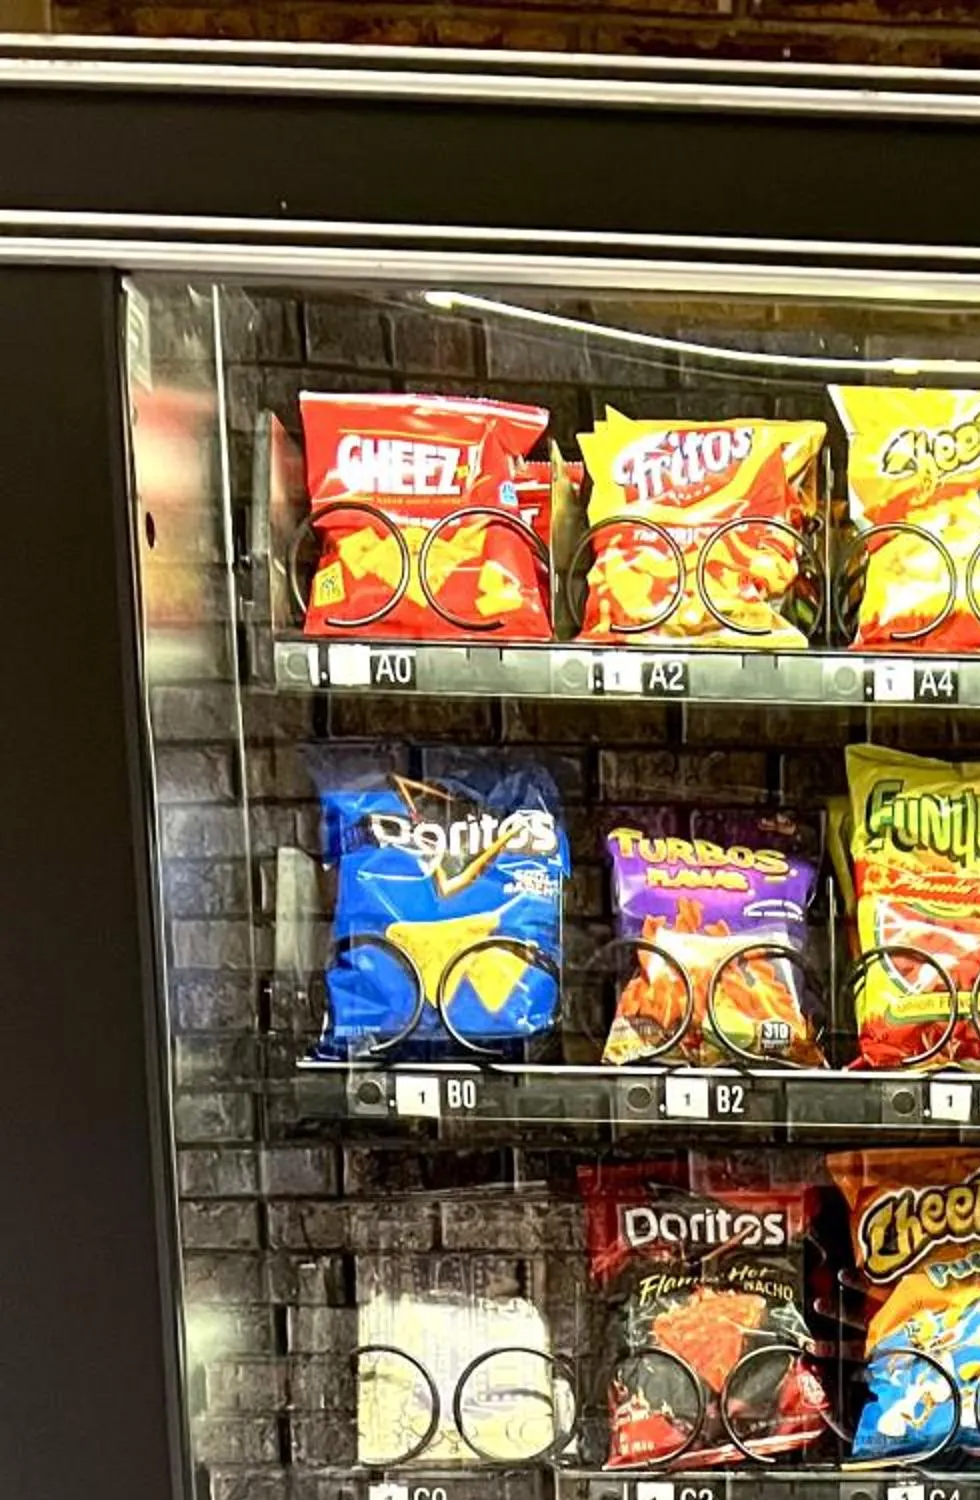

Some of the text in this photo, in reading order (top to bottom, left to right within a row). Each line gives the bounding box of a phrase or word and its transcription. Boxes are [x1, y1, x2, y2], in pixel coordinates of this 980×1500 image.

[613, 427, 754, 502] Fritos
[375, 655, 412, 685] A0
[649, 659, 684, 689] A2
[918, 674, 955, 697] A4
[370, 809, 558, 858] Doritos
[447, 1079, 477, 1108] B0
[716, 1084, 745, 1113] B2
[624, 1205, 788, 1248] Doritos
[743, 1277, 795, 1302] NACHO
